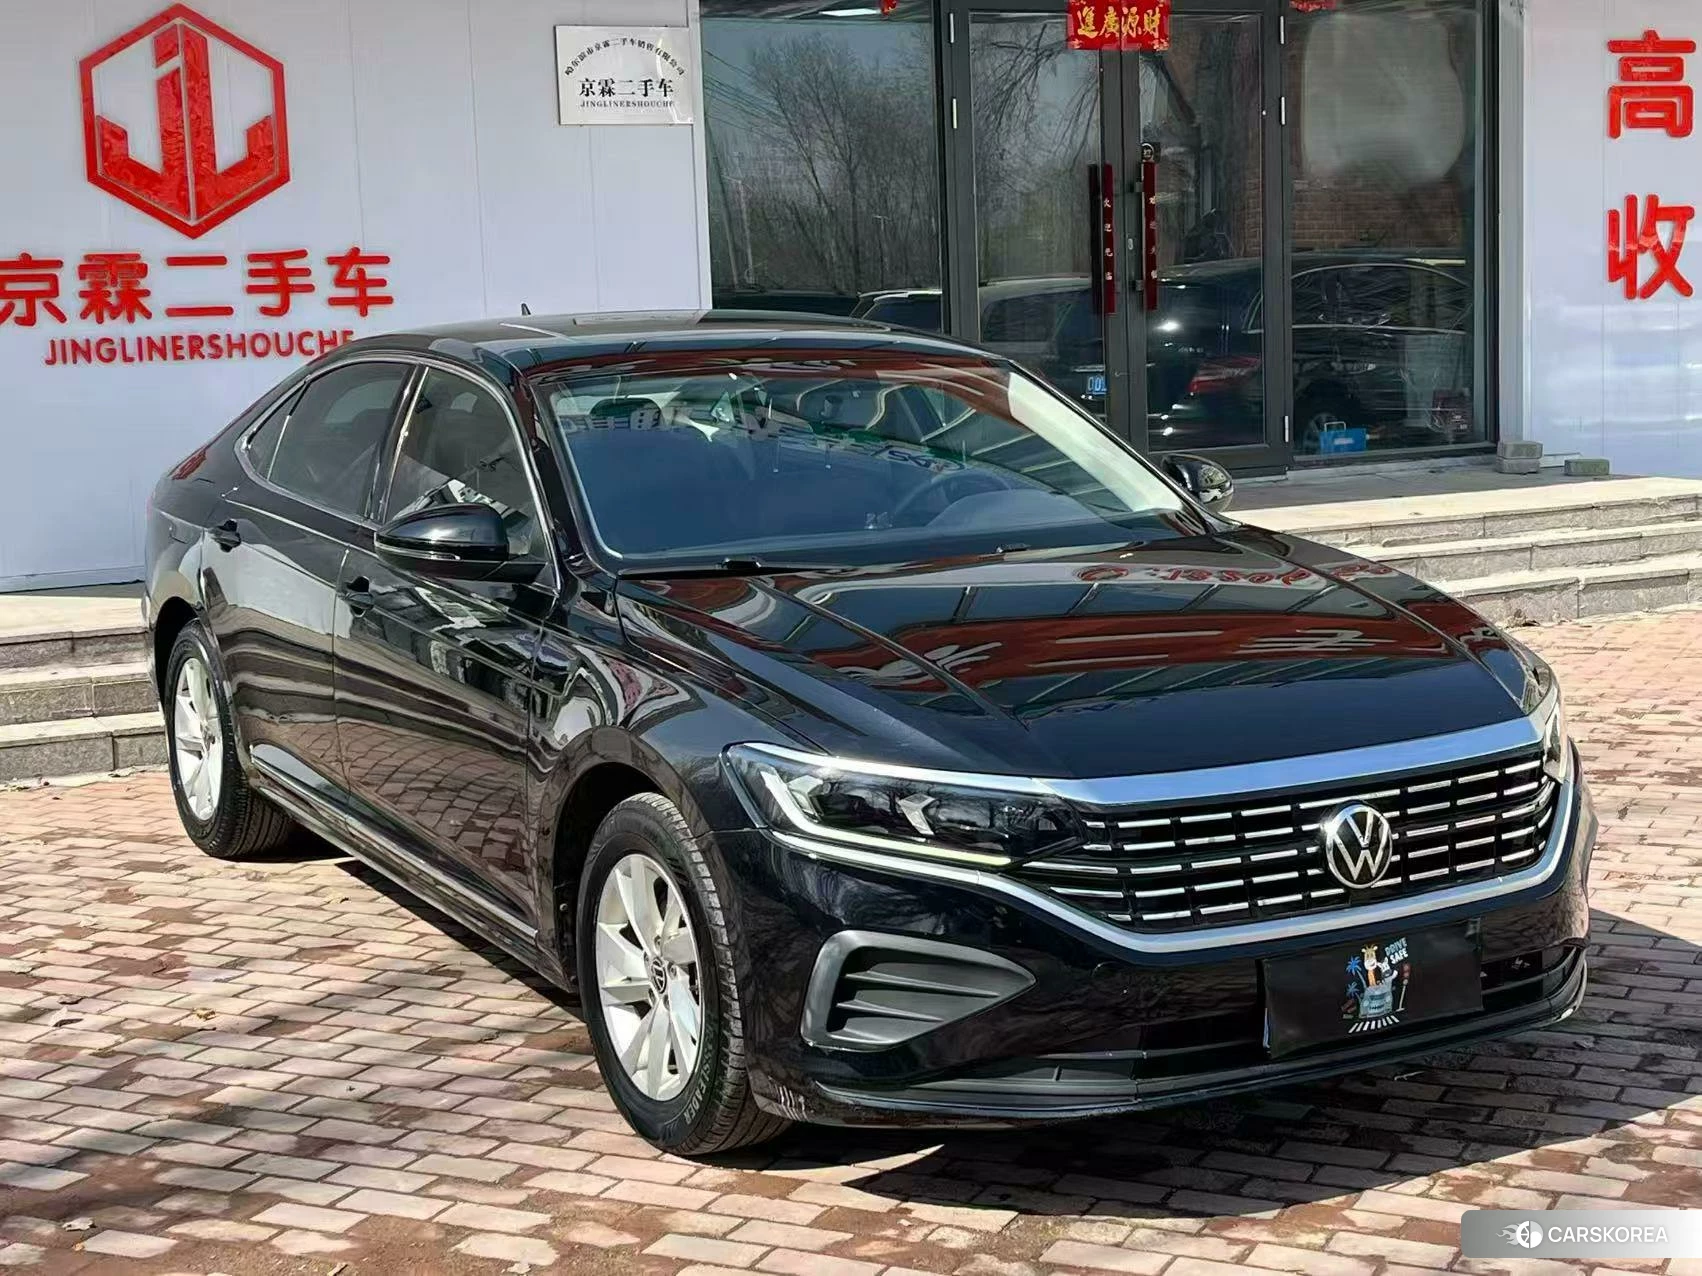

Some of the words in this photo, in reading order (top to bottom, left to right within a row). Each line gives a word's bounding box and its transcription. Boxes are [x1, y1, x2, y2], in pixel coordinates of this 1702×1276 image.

[579, 78, 674, 98] 京霖二手车
[0, 246, 393, 327] 京霖二手车
[1384, 937, 1408, 956] DRIVE
[1389, 947, 1409, 964] SAFE
